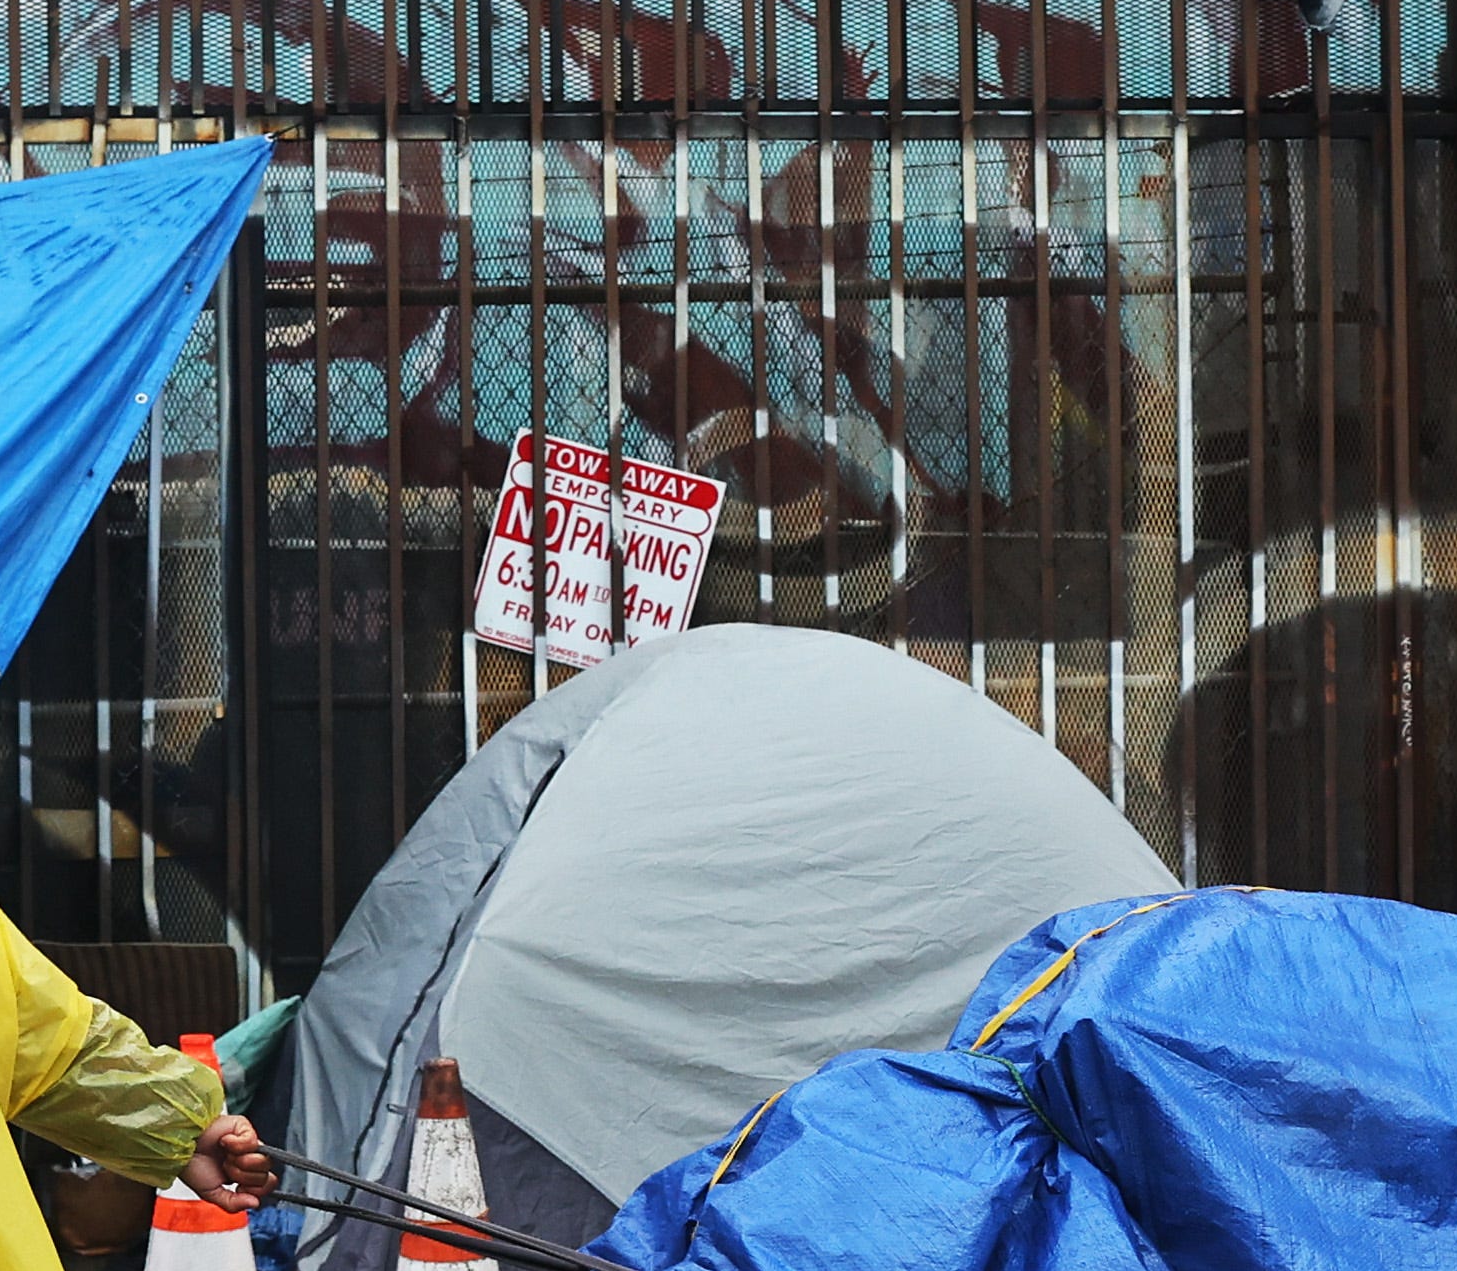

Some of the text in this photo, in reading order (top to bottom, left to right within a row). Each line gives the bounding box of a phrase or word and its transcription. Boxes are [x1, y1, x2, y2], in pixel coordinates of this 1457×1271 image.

[504, 489, 567, 546] NO
[503, 600, 640, 650] FRDAY ONY
